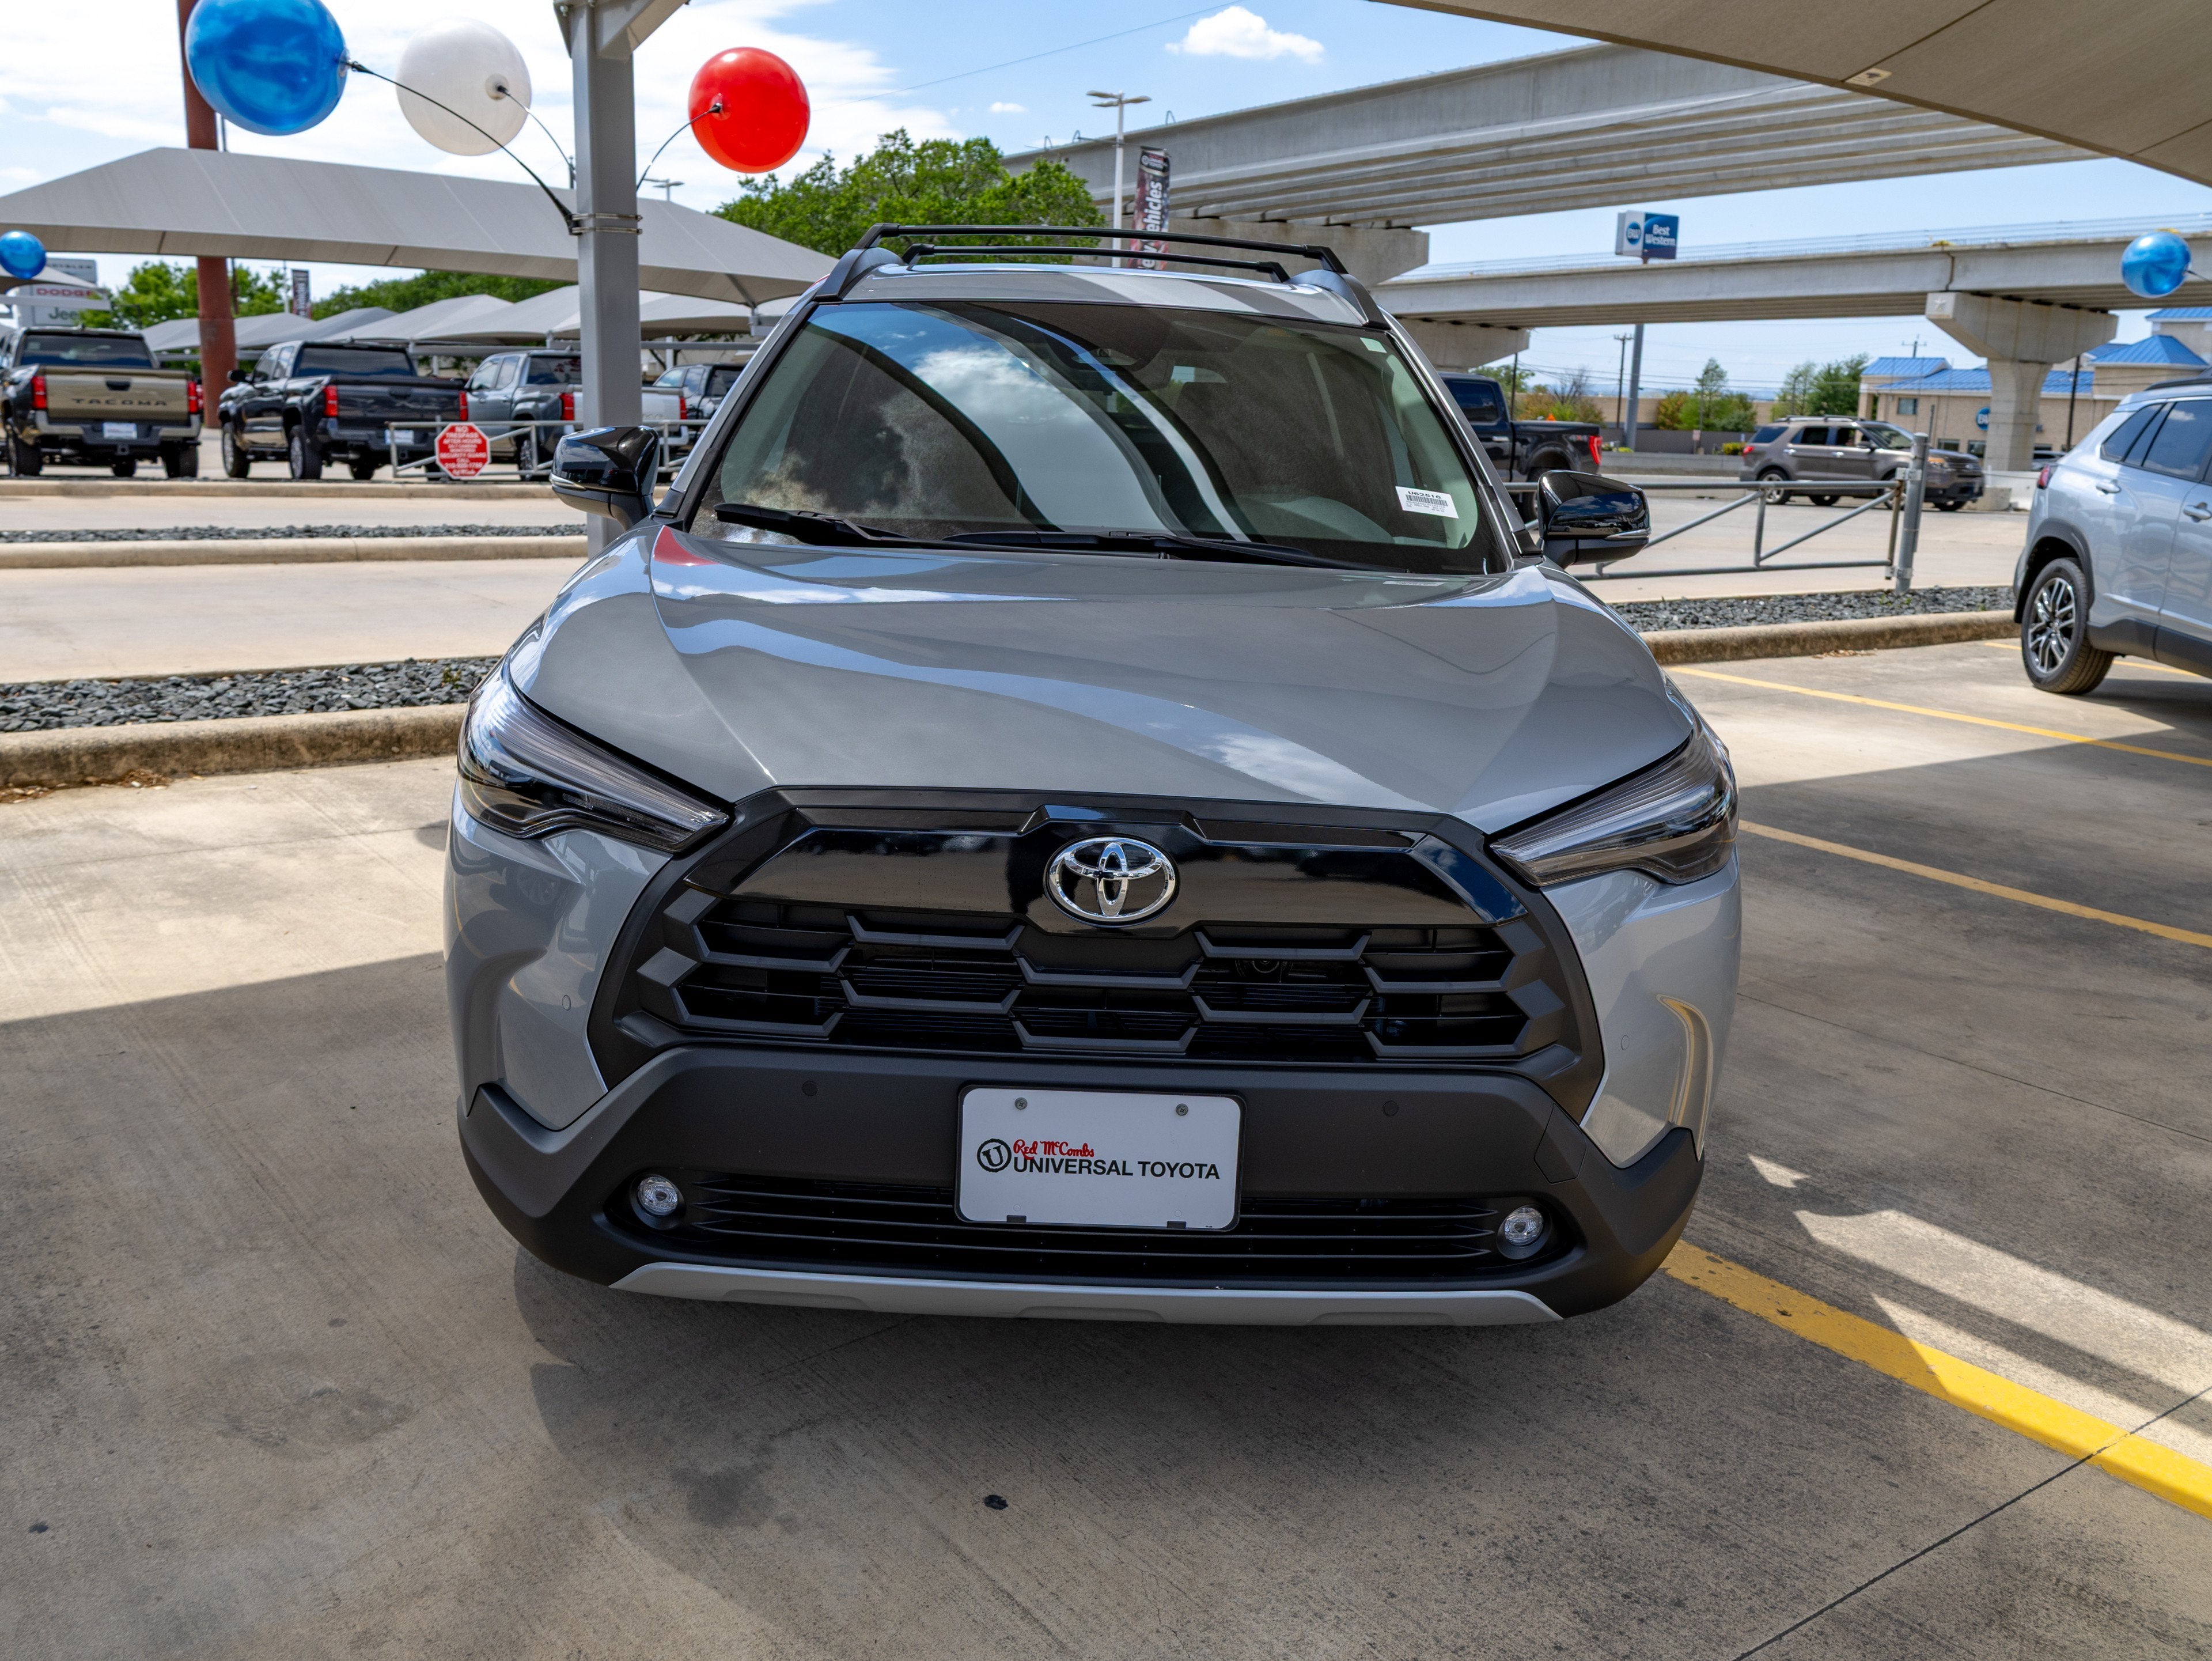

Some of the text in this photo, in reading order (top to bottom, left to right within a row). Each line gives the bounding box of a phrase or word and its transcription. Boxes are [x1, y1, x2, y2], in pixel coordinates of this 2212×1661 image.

[1142, 181, 1162, 242] ehicles
[1652, 224, 1671, 236] Best
[1645, 233, 1676, 246] Western
[49, 307, 78, 319] Jee
[1408, 491, 1441, 499] U62516
[1013, 1139, 1094, 1160] Red McCombs
[1013, 1156, 1220, 1179] UNIVERSAL TOYOTA
